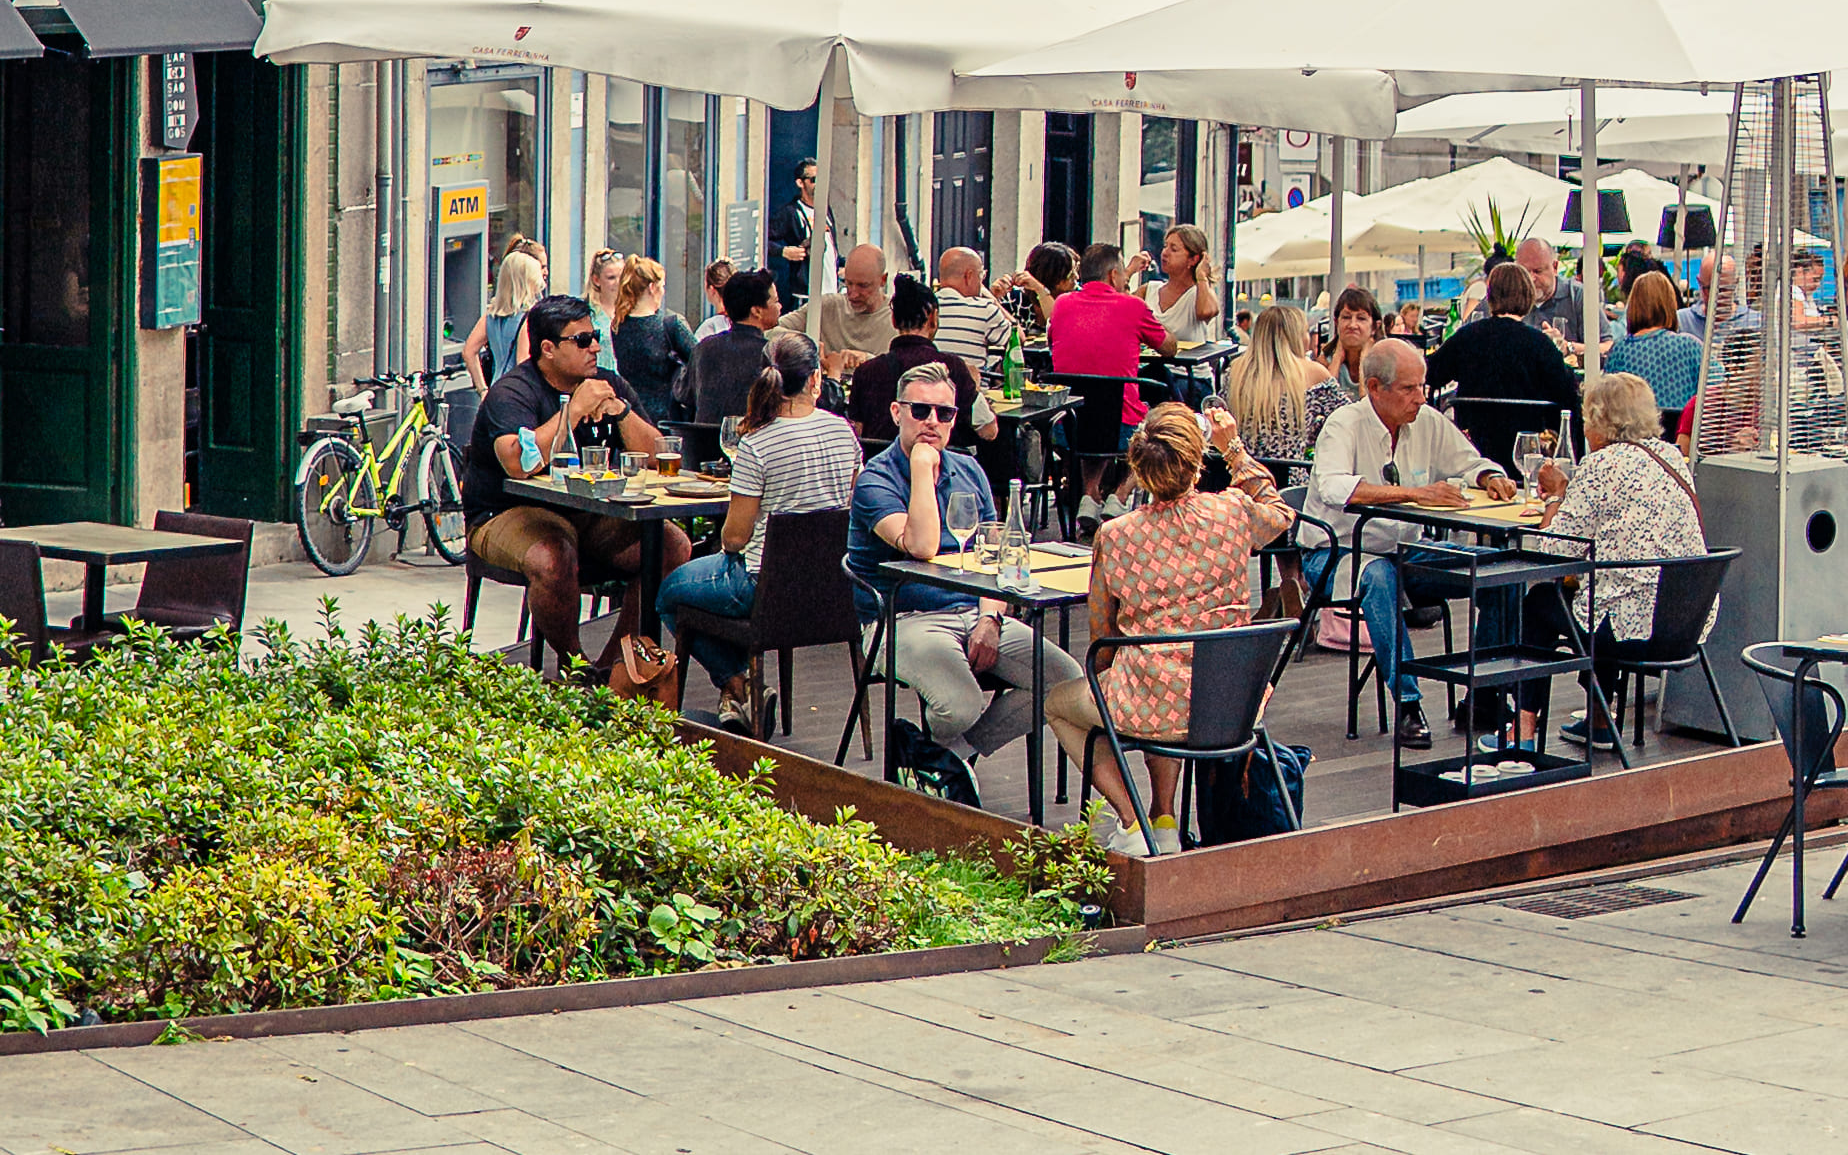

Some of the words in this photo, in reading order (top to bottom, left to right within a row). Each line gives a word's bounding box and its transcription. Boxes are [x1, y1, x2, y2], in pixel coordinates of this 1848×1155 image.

[472, 46, 494, 54] CASA
[166, 100, 186, 112] DOM
[1091, 99, 1113, 107] CASA
[1115, 99, 1166, 111] FERREIRNHA
[167, 127, 186, 139] GOS
[449, 195, 479, 216] ATM
